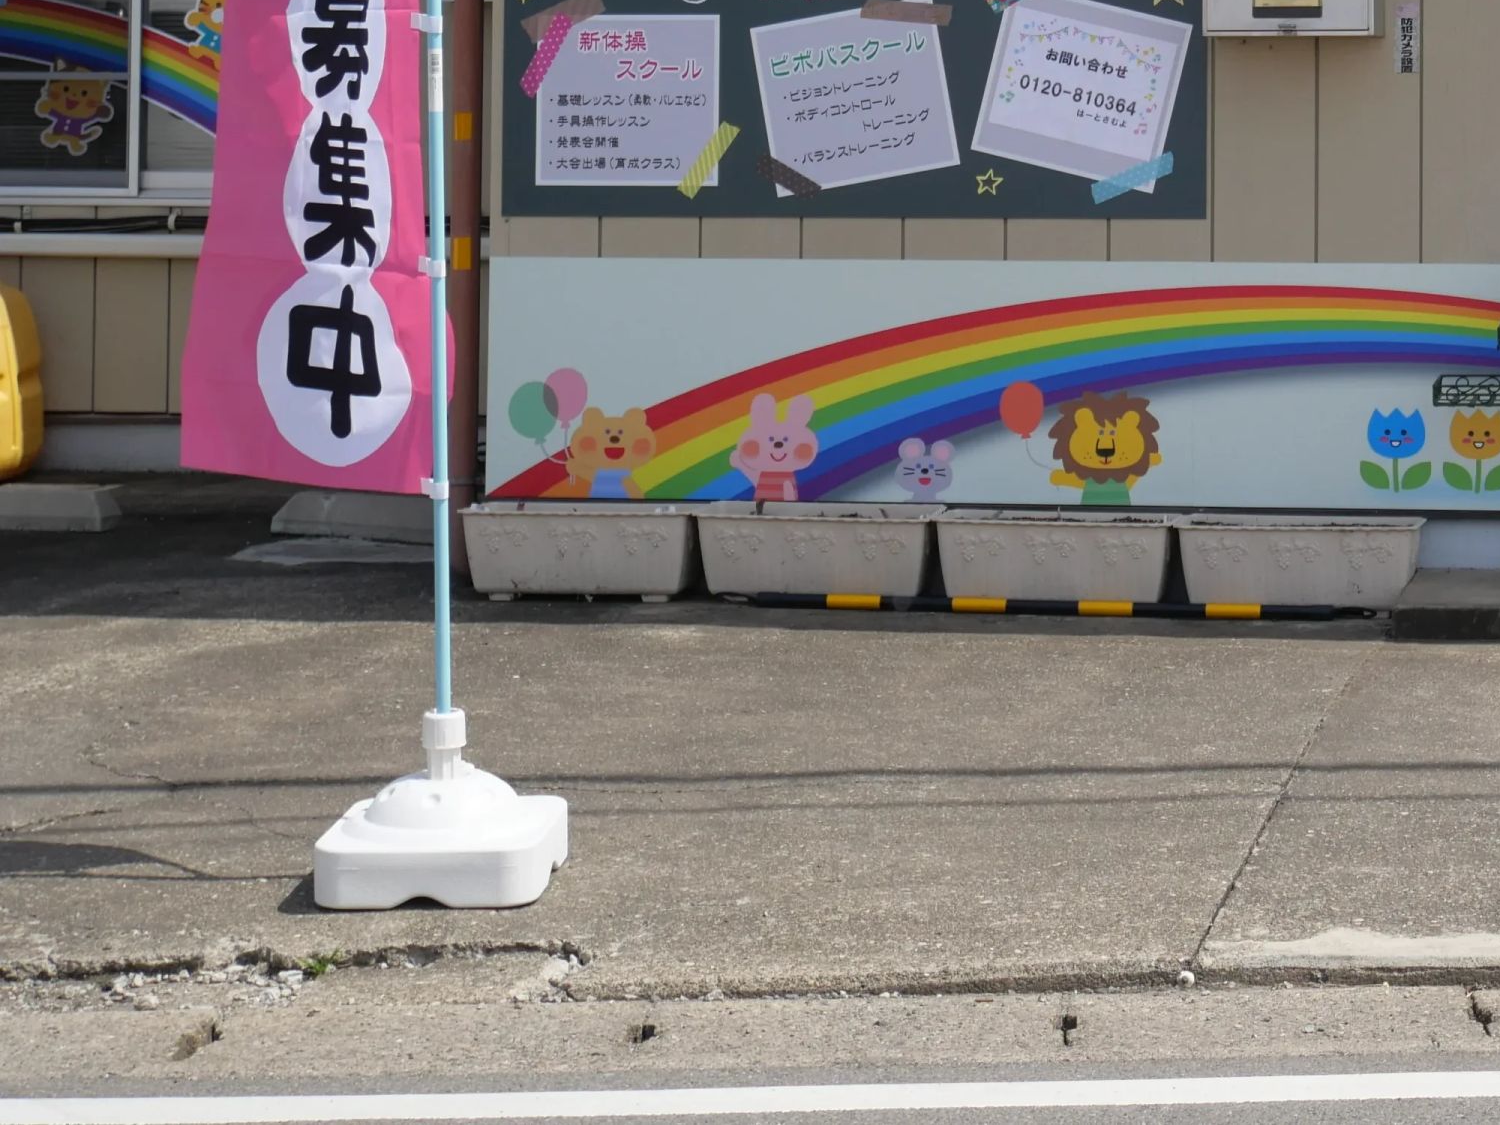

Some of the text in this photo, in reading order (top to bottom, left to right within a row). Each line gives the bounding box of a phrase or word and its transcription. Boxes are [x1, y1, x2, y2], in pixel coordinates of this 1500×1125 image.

[579, 31, 647, 52] 新体操
[770, 31, 925, 77] ビボバスクール
[1400, 17, 1413, 74] 防犯カメラ設置
[617, 59, 702, 80] スクール
[1045, 48, 1128, 79] お問い合わせ
[790, 71, 900, 102] ビジョントレーニング
[1019, 74, 1137, 116] 0120-810364
[557, 115, 651, 128] 手具操作レッスン
[794, 94, 896, 123] ボディコントロール
[863, 108, 930, 132] トレーニング
[557, 136, 620, 148] 発表会開催
[802, 132, 916, 164] バランストレーニング
